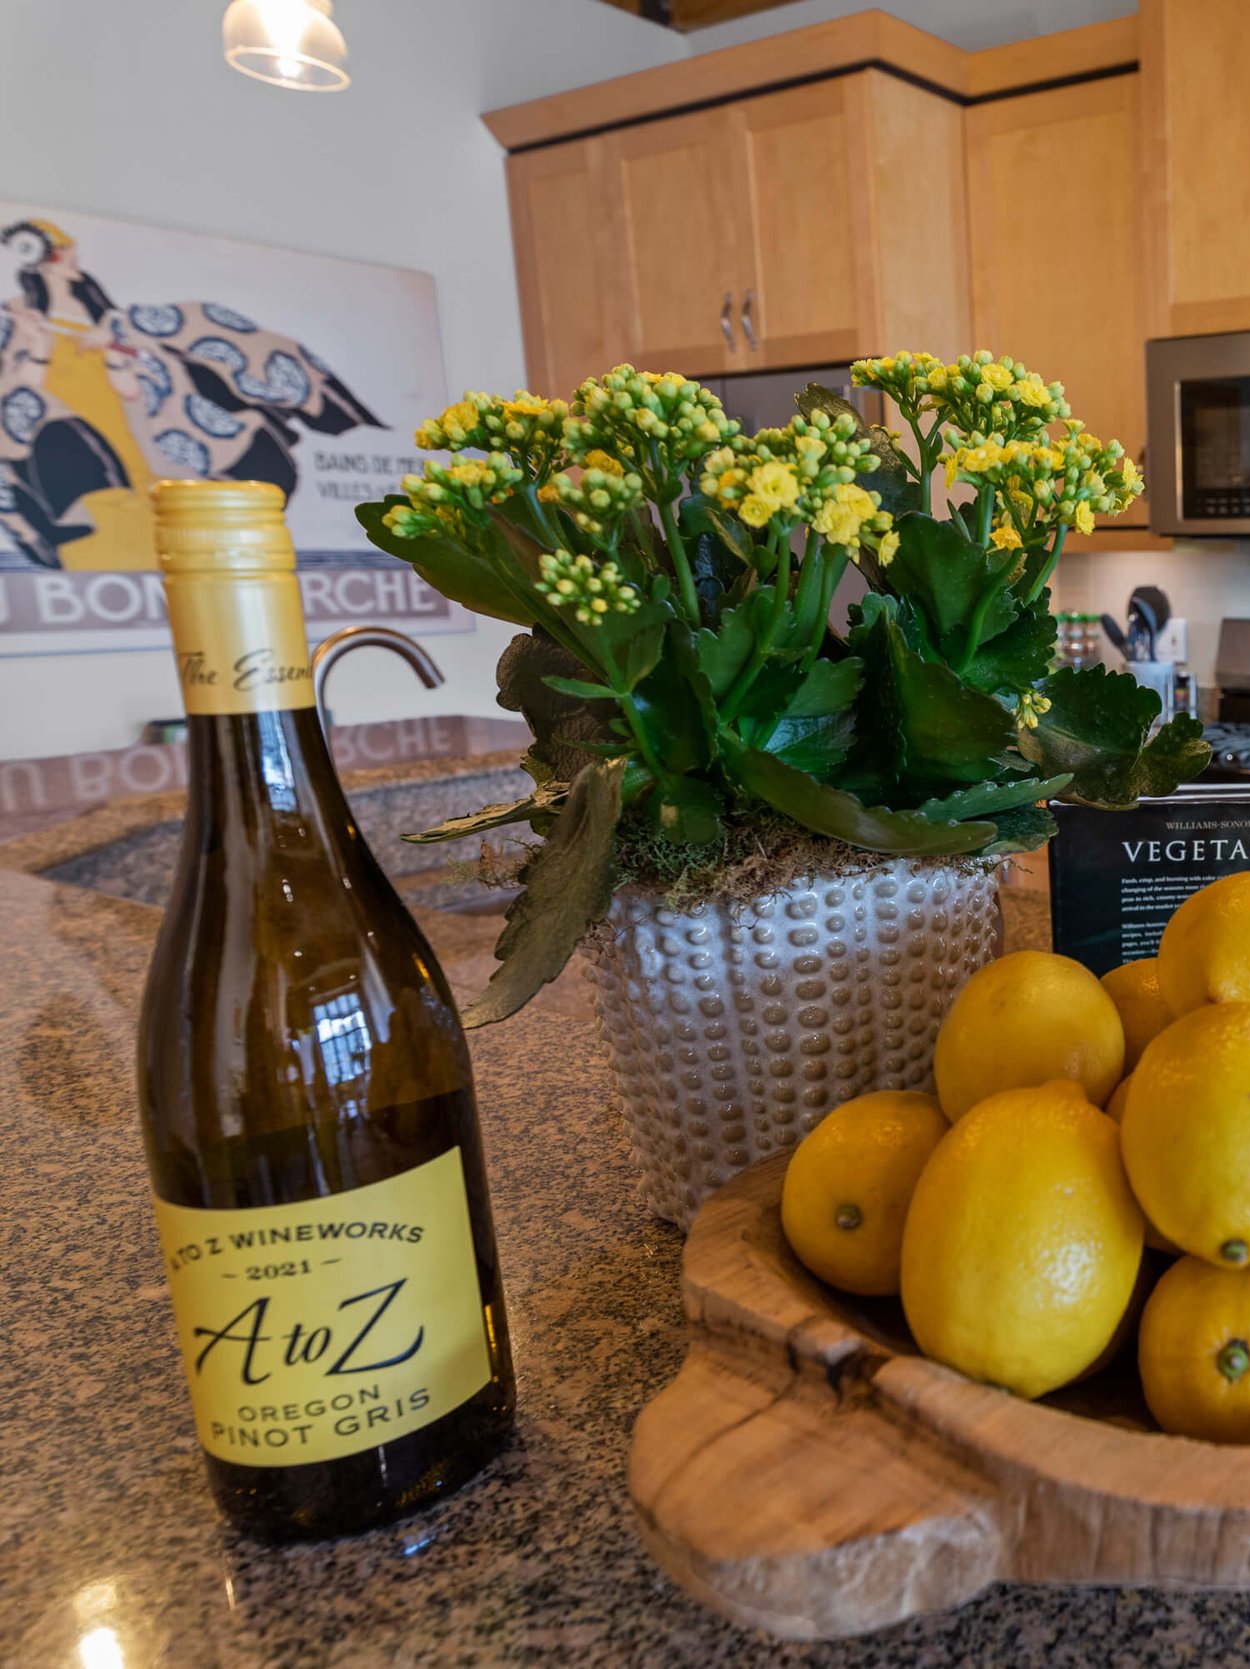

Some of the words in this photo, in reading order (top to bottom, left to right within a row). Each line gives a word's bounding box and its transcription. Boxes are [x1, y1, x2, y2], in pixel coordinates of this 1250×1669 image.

[299, 570, 435, 615] RCHE
[177, 1244, 203, 1264] TO
[205, 1237, 223, 1255] Z
[230, 1221, 425, 1250] WINEWORKS
[245, 1259, 312, 1281] 2021
[193, 1296, 271, 1387] A
[281, 1322, 332, 1368] to
[324, 1277, 426, 1377] Z
[211, 1421, 313, 1449] PINOT
[334, 1388, 432, 1437] GRIS
[237, 1384, 382, 1422] OREGON
